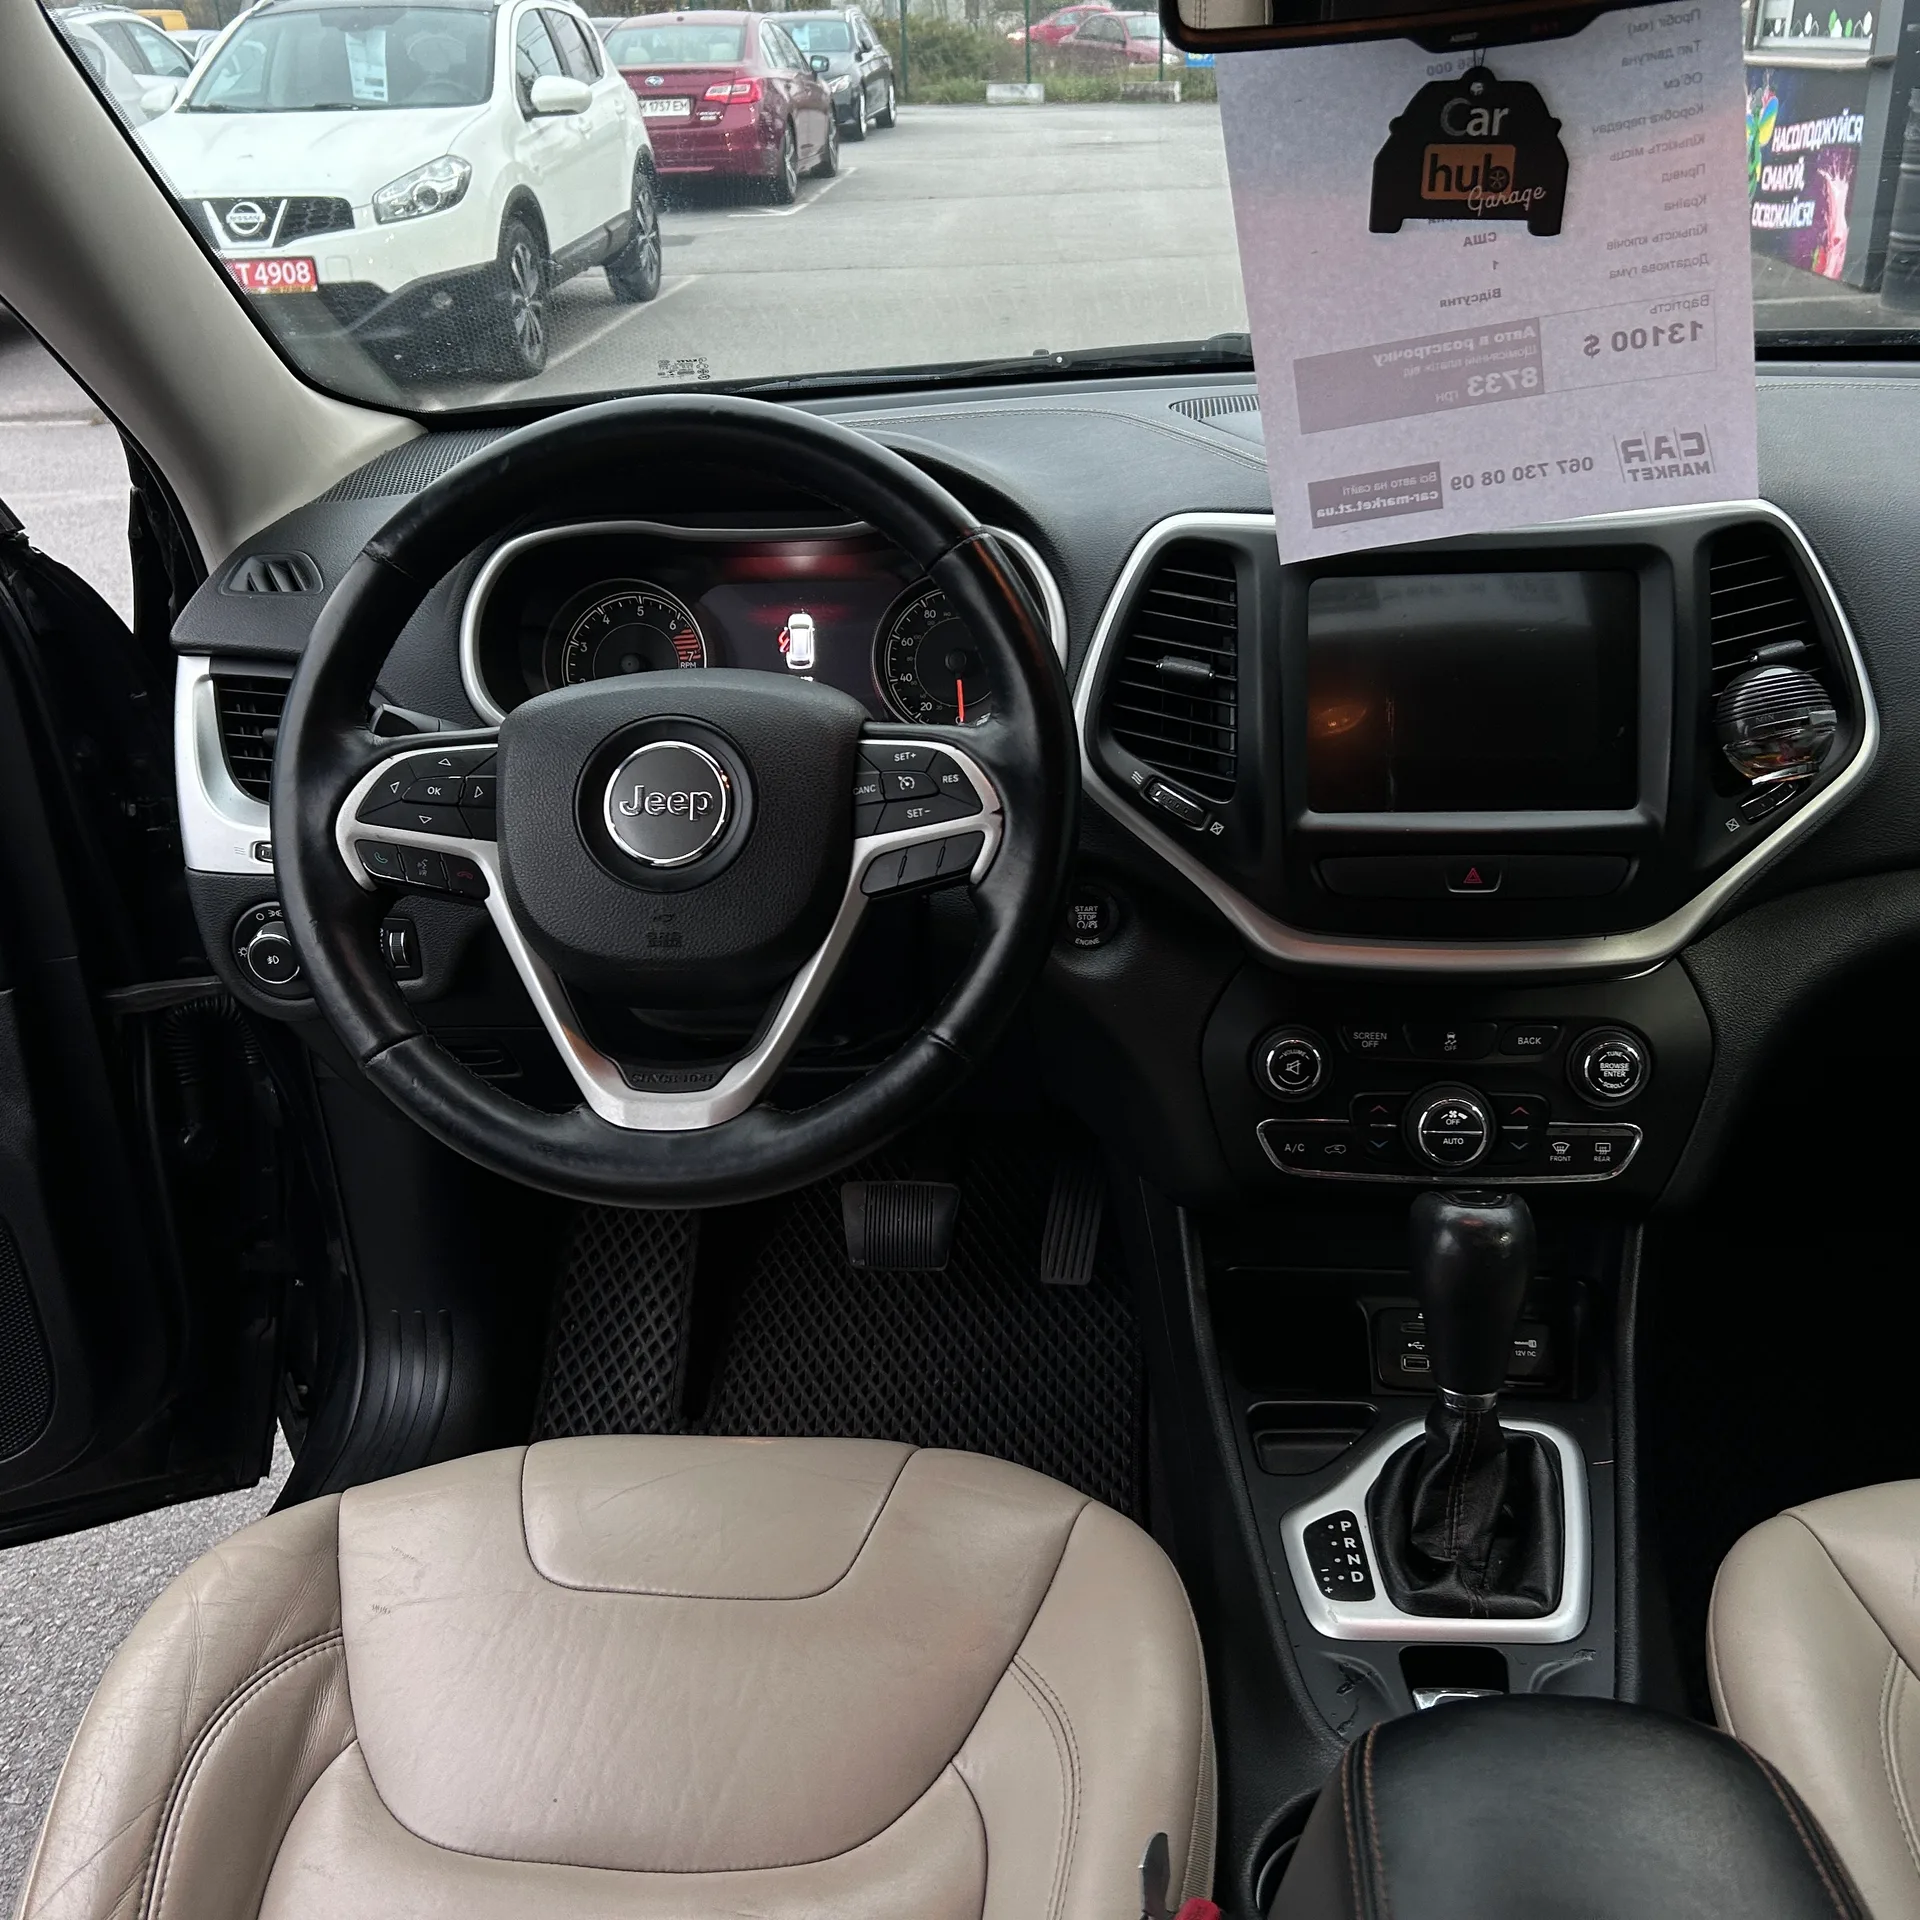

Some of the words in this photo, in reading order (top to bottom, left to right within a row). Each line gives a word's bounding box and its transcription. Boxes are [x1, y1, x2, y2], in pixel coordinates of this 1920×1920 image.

[1440, 97, 1509, 137] Car
[1427, 153, 1510, 193] hub
[1467, 184, 1547, 217] Garage
[254, 260, 311, 286] 4908
[637, 607, 644, 616] 5
[924, 610, 936, 619] 80
[602, 615, 610, 625] 4
[669, 620, 677, 630] 6
[580, 642, 587, 651] 3
[901, 637, 914, 647] 60
[687, 652, 694, 661] 7
[680, 661, 697, 669] RPM
[900, 672, 913, 683] 40
[920, 702, 932, 711] 20
[894, 751, 917, 762] SET+
[942, 774, 959, 783] RES
[427, 786, 442, 796] OK
[852, 784, 877, 796] CANC
[619, 784, 714, 821] Jeep
[1353, 1032, 1387, 1040] SCREEN
[1517, 1036, 1542, 1046] BACK
[1361, 1040, 1380, 1048] OFF
[1282, 1049, 1306, 1057] VOLUME
[1599, 1062, 1630, 1070] BROWSE
[1603, 1070, 1626, 1078] ENTER
[1602, 1081, 1625, 1089] SCROLL
[1445, 1118, 1461, 1126] OFF
[1442, 1137, 1464, 1145] AUTO
[1284, 1143, 1305, 1153] A/C
[1340, 1521, 1352, 1532] P
[1343, 1537, 1357, 1549] R
[1346, 1553, 1361, 1566] N
[1350, 1571, 1364, 1583] D
